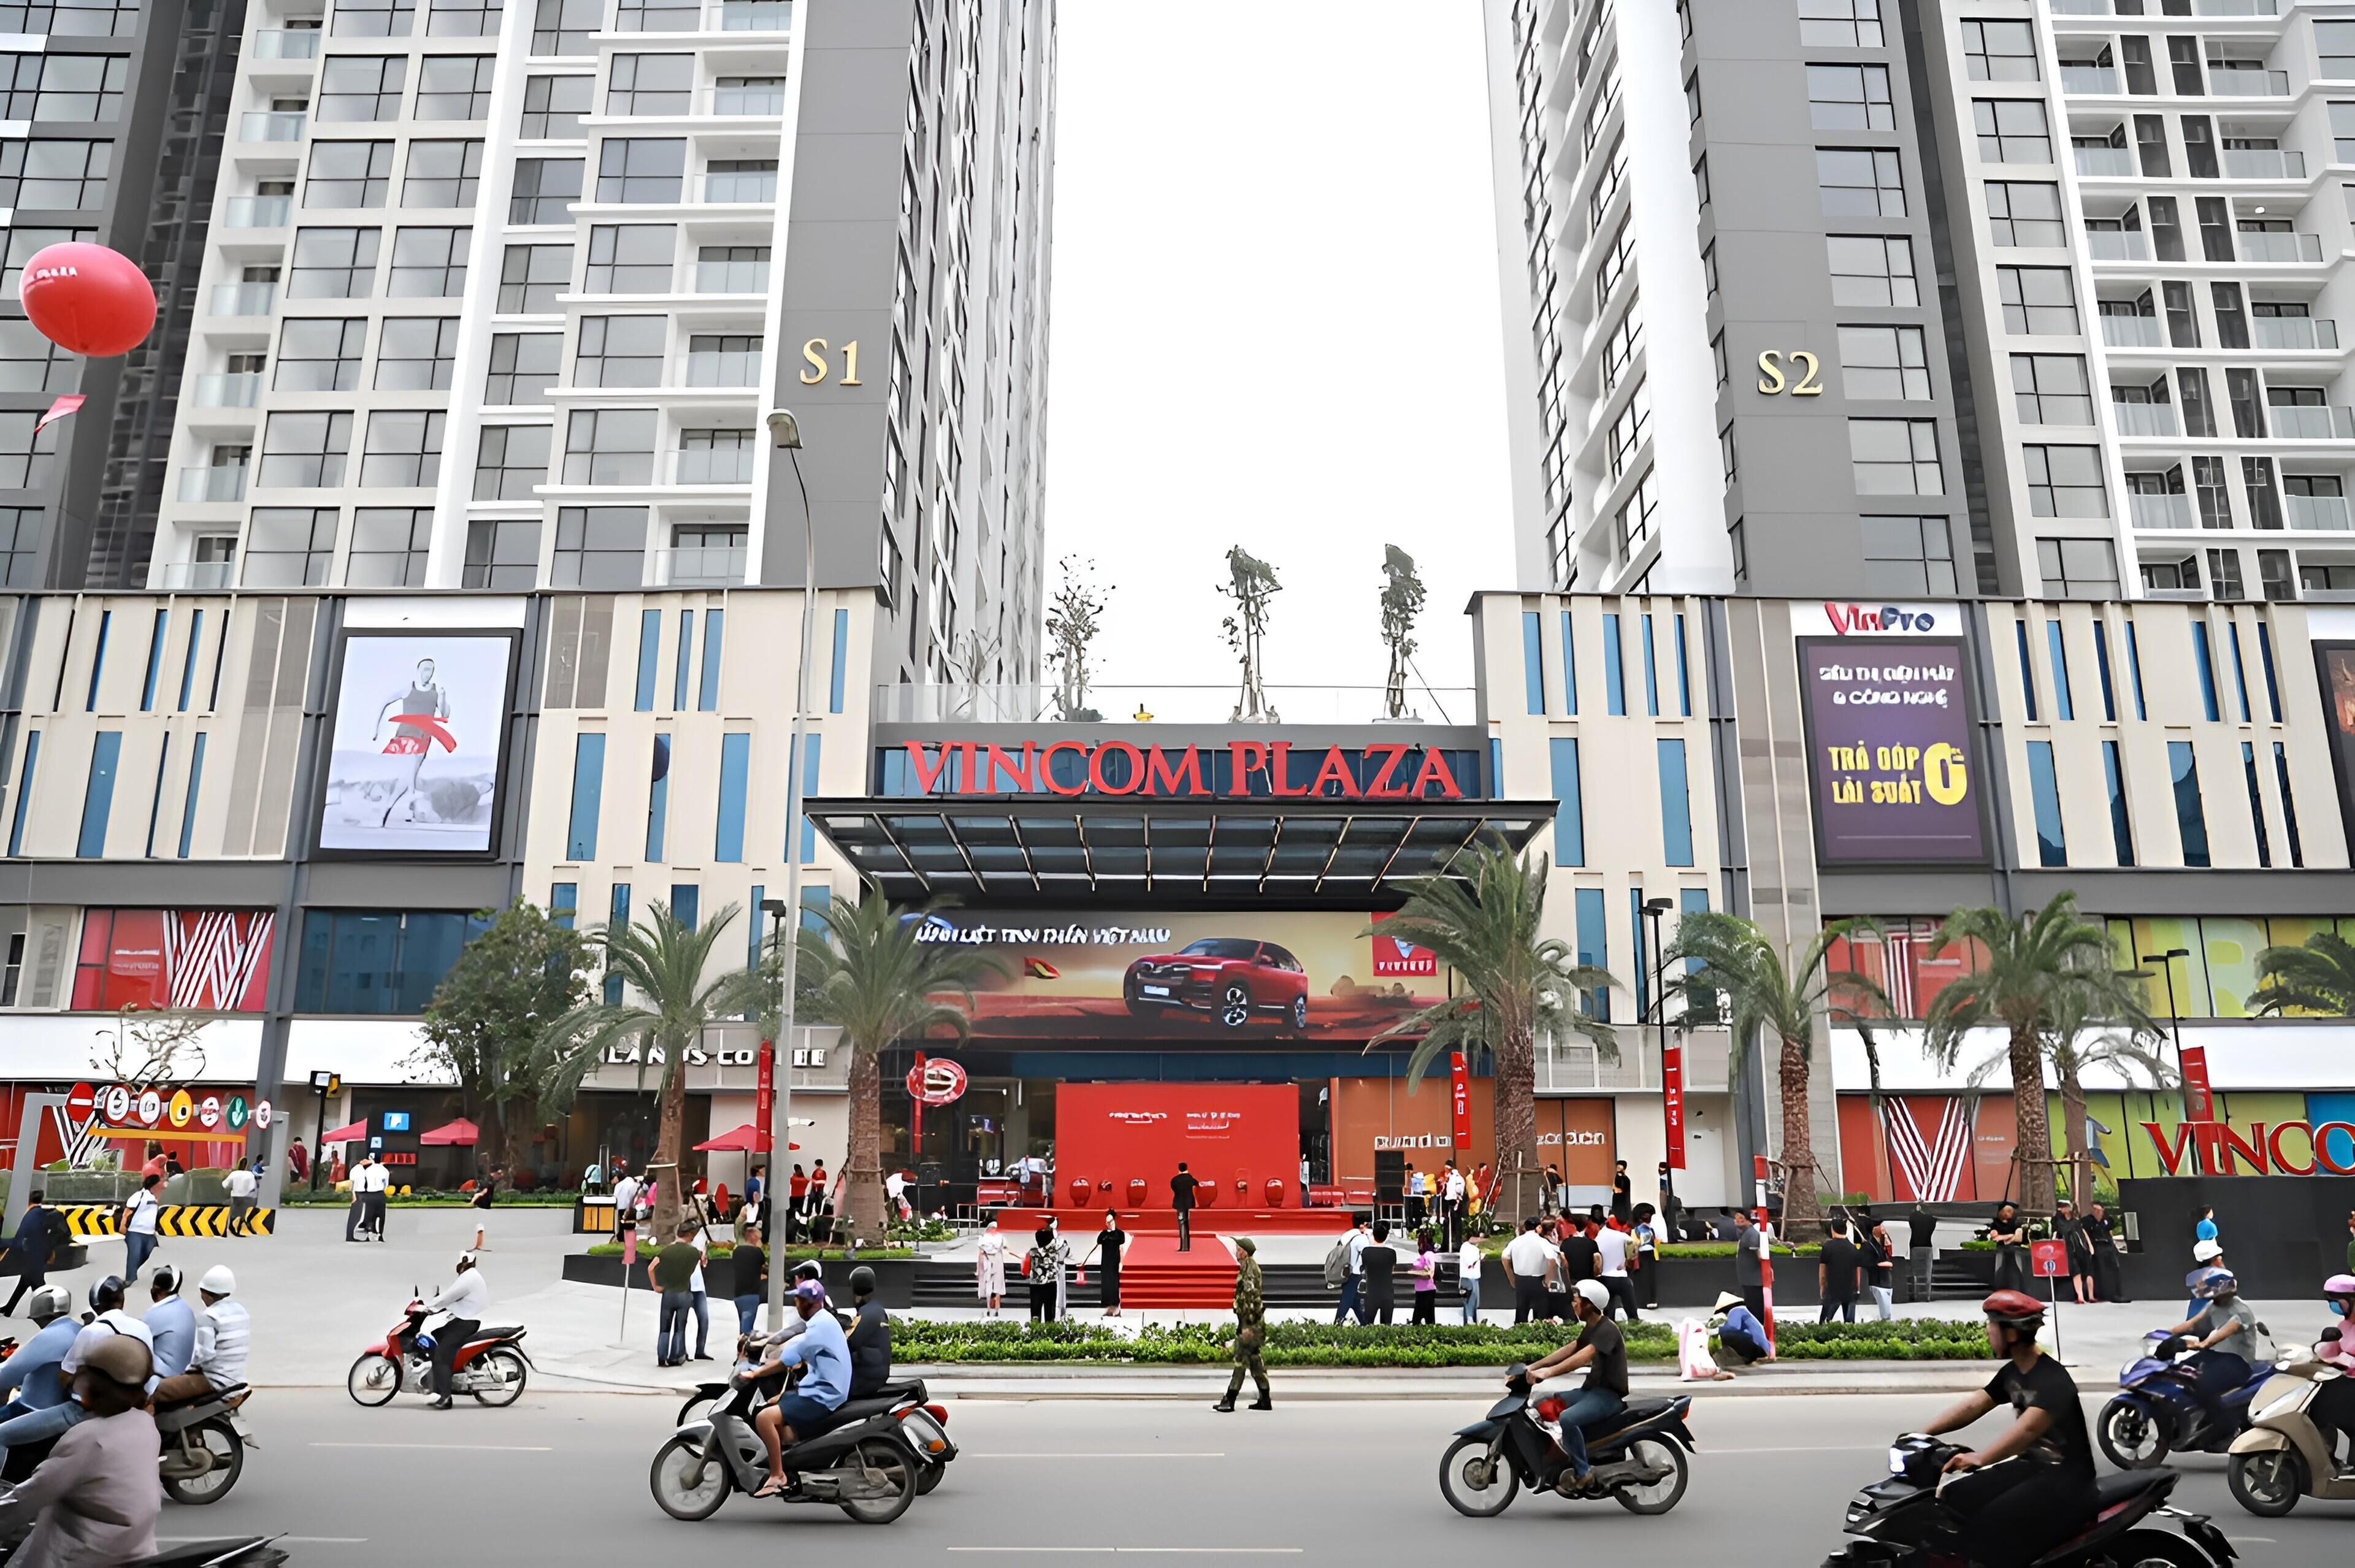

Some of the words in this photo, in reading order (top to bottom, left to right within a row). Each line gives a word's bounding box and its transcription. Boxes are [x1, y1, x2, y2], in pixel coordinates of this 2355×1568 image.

[800, 338, 862, 386] S1
[1758, 350, 1823, 396] S2
[903, 740, 1213, 795] VINCOM
[1228, 741, 1465, 799] PLAZA
